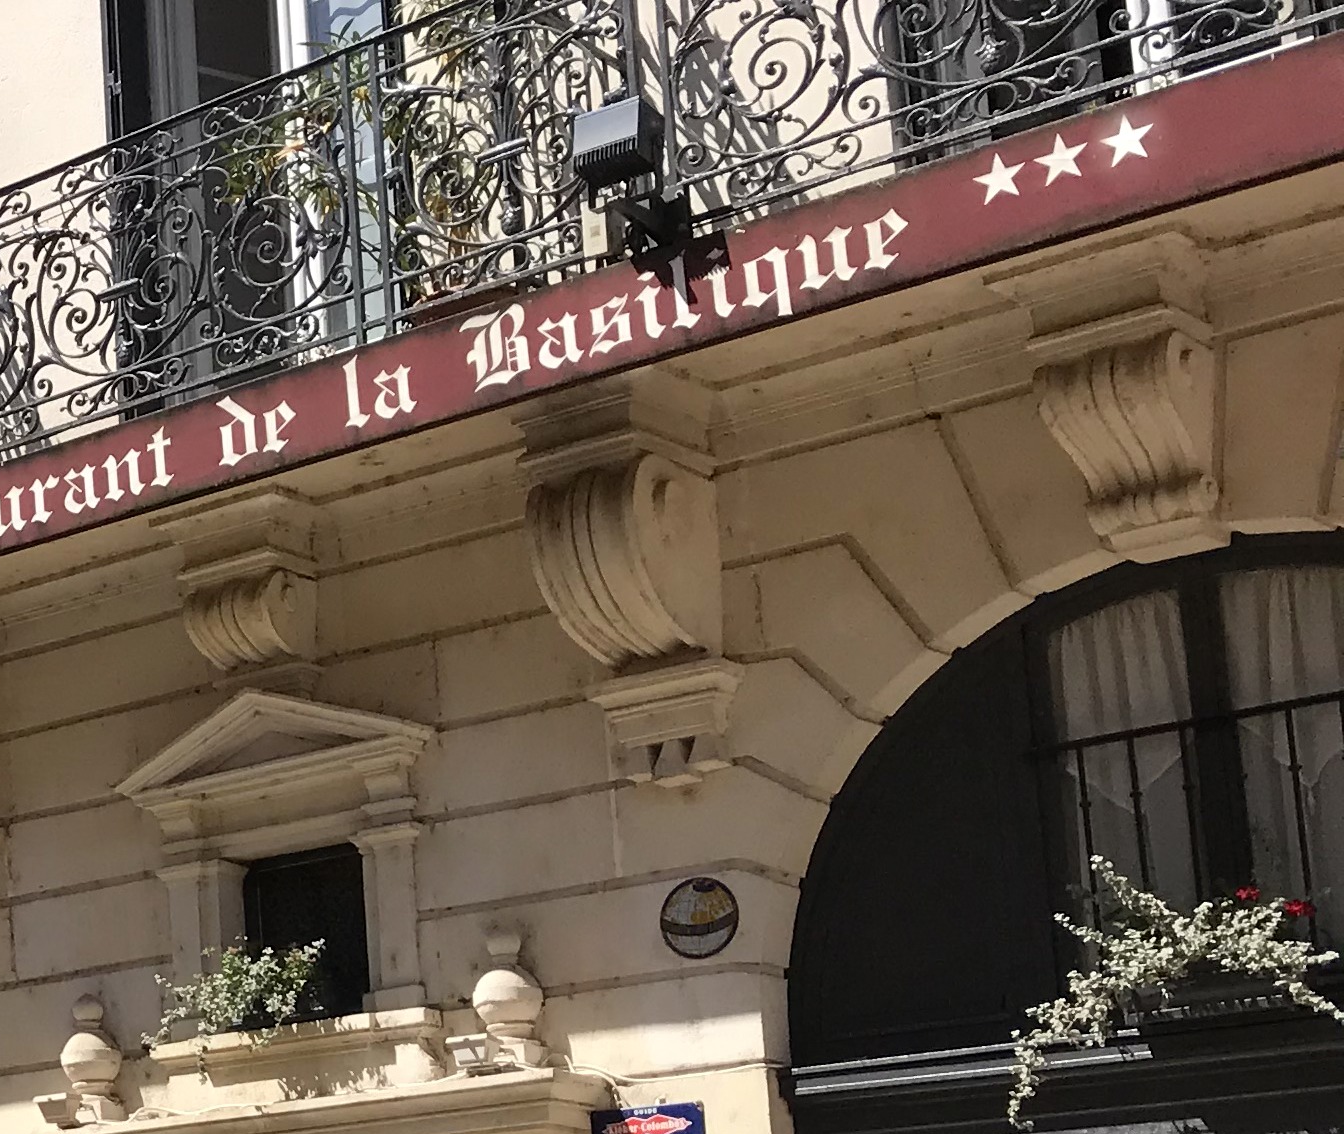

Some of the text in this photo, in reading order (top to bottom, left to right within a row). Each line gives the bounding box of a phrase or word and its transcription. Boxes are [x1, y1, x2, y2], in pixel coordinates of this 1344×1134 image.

[217, 395, 297, 468] de
[341, 354, 418, 428] la
[459, 208, 909, 393] Basilique
